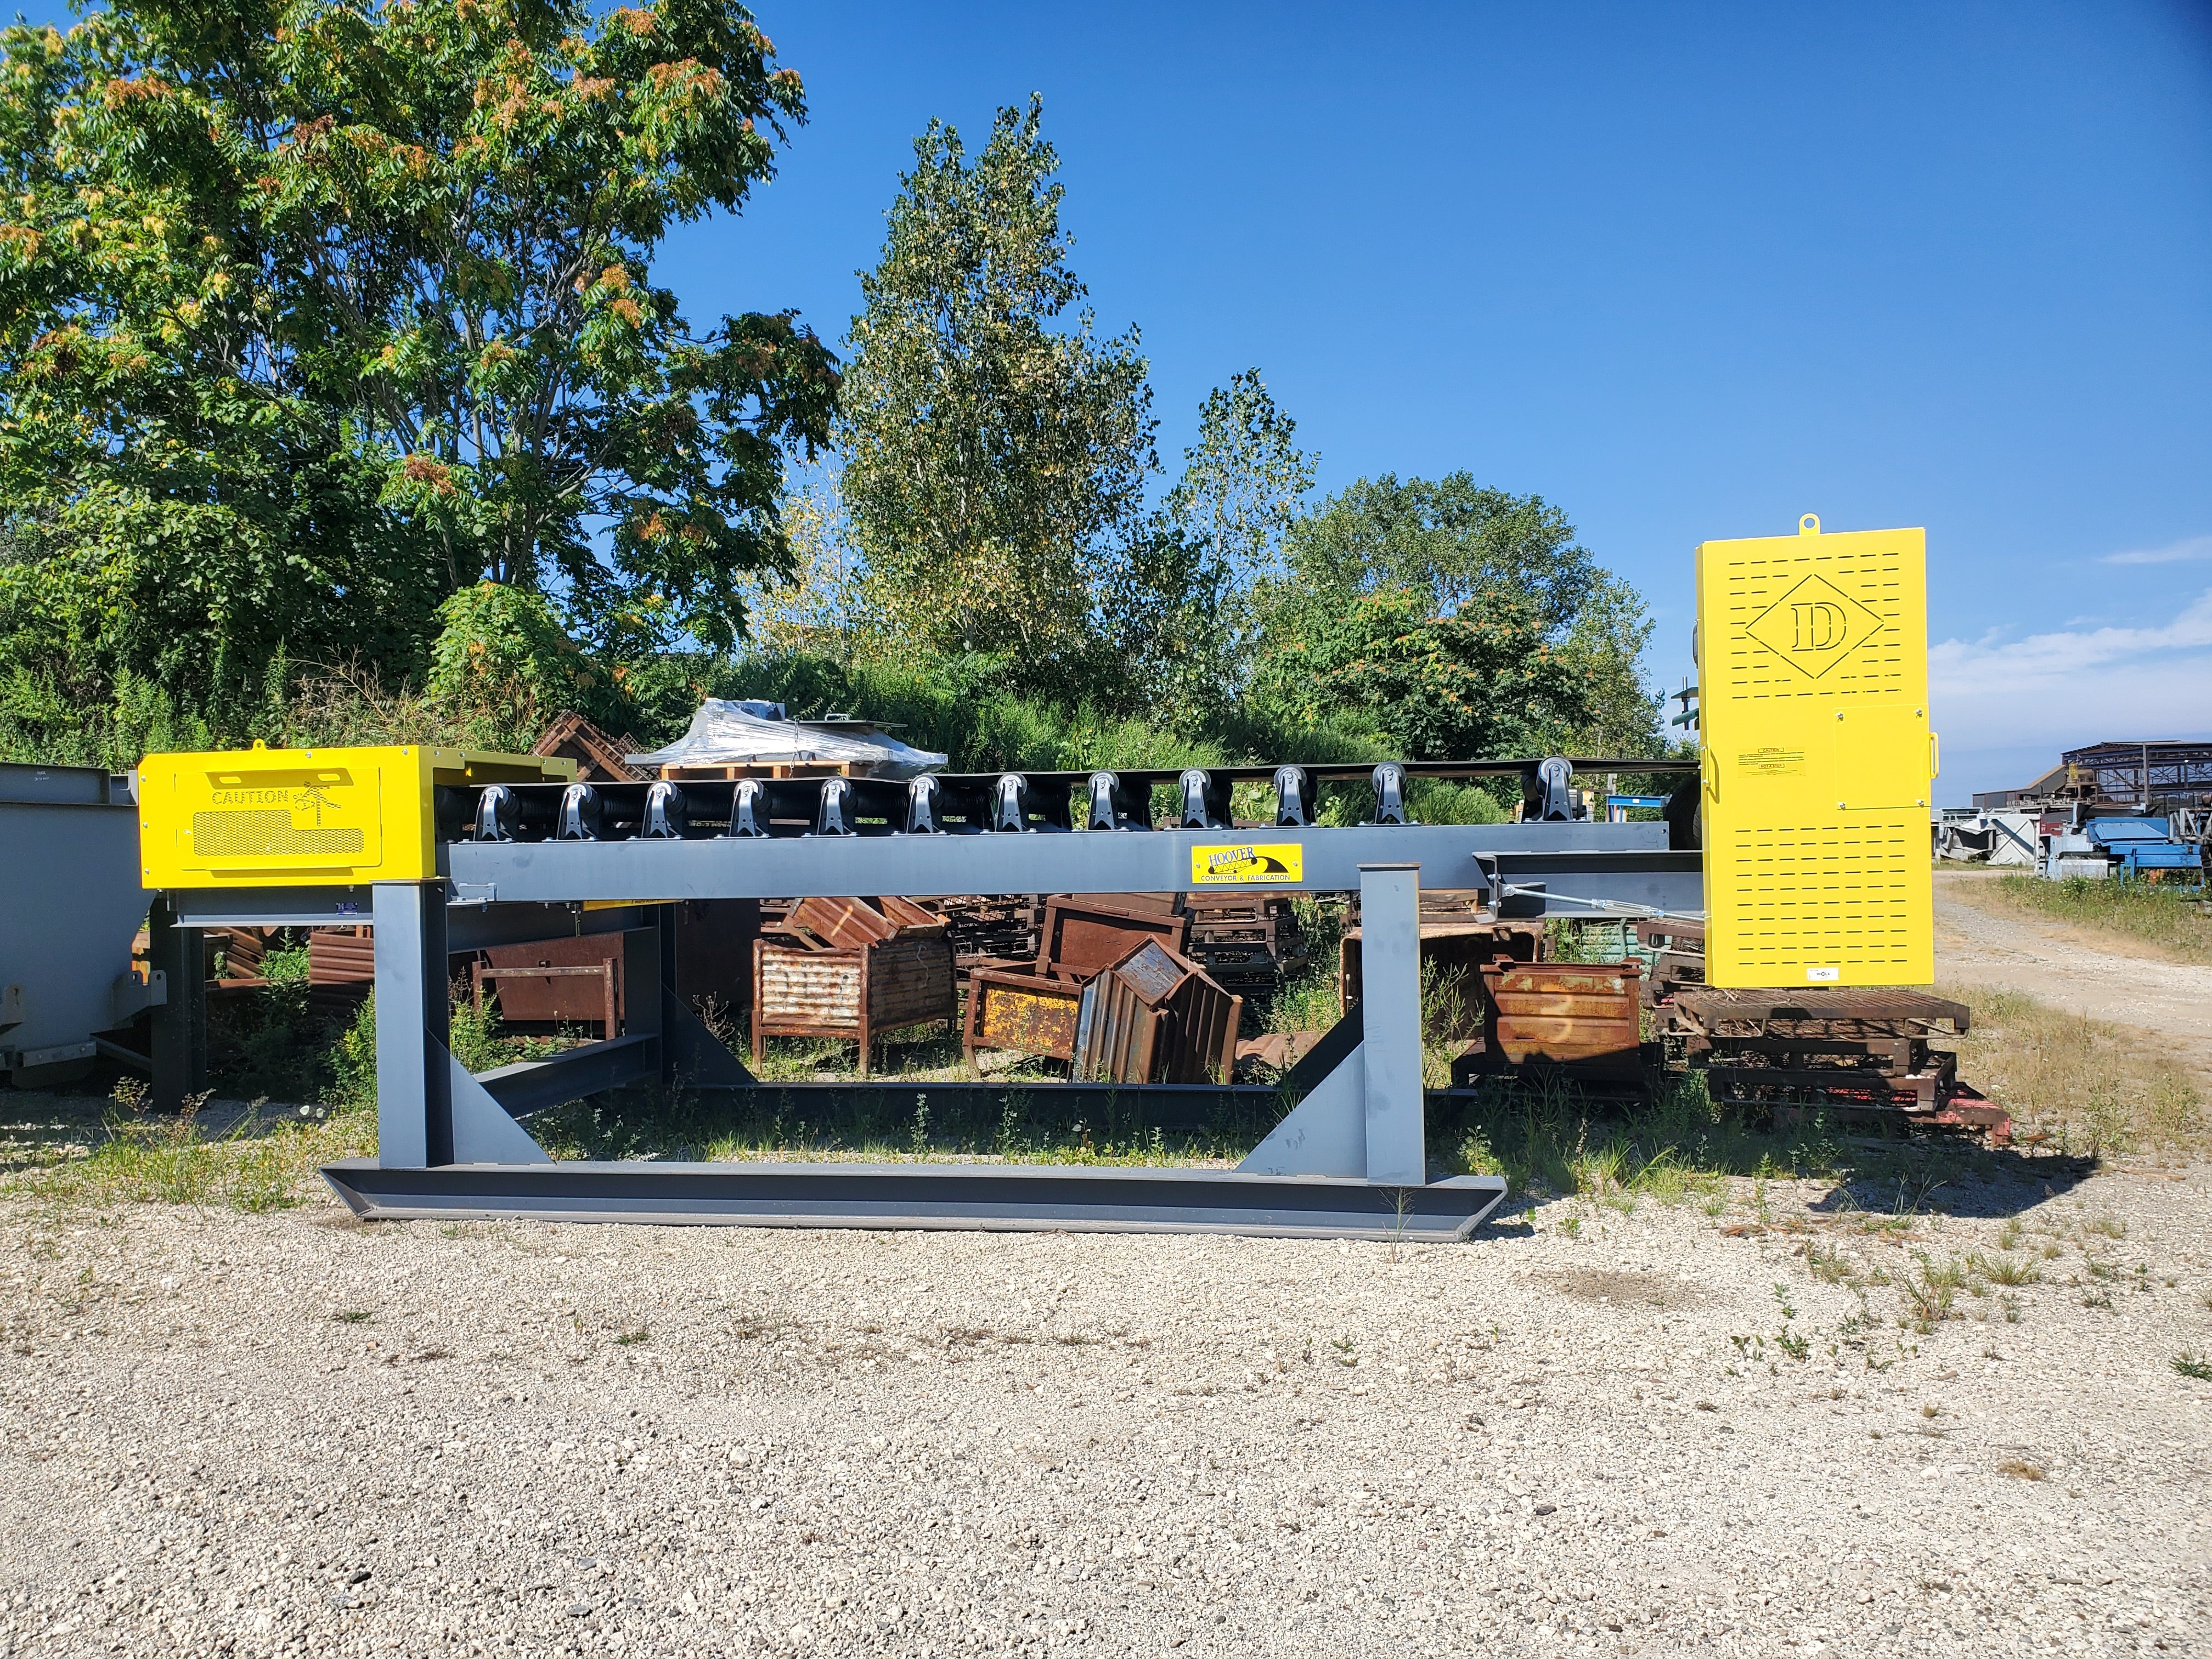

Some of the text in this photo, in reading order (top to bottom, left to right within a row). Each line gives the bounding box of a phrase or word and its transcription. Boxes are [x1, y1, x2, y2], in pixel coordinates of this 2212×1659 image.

[1791, 601, 1847, 652] D
[212, 790, 289, 805] CAUTION
[1207, 847, 1256, 866] HOOVER
